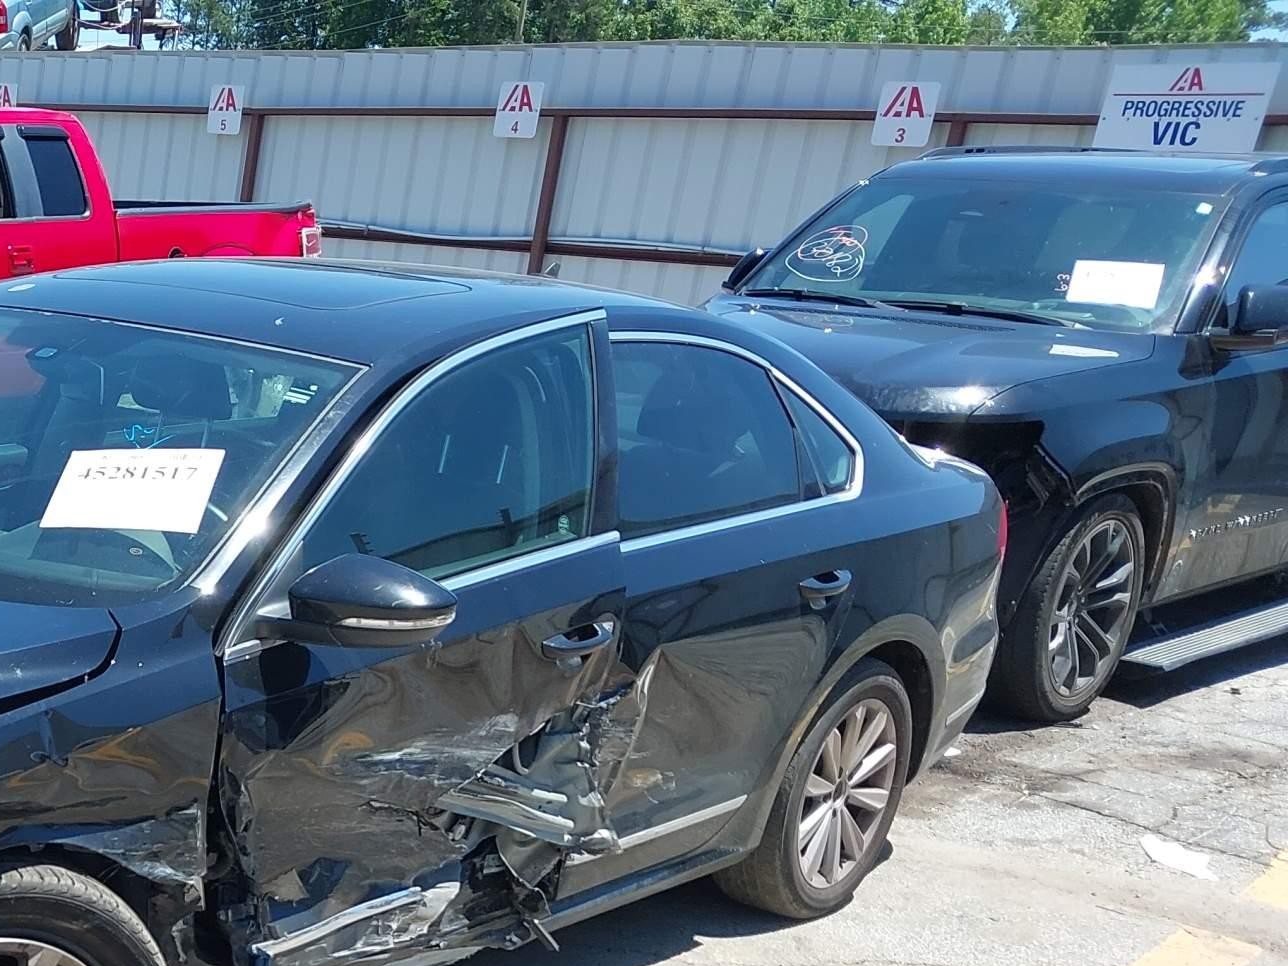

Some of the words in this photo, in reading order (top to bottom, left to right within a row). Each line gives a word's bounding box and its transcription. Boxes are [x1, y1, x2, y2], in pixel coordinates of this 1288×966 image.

[1121, 100, 1246, 118] PROGRESSIVE
[220, 119, 227, 131] 5
[511, 120, 519, 134] 4
[894, 127, 907, 143] 3
[1152, 120, 1201, 146] VIC
[78, 466, 198, 480] 45281517
